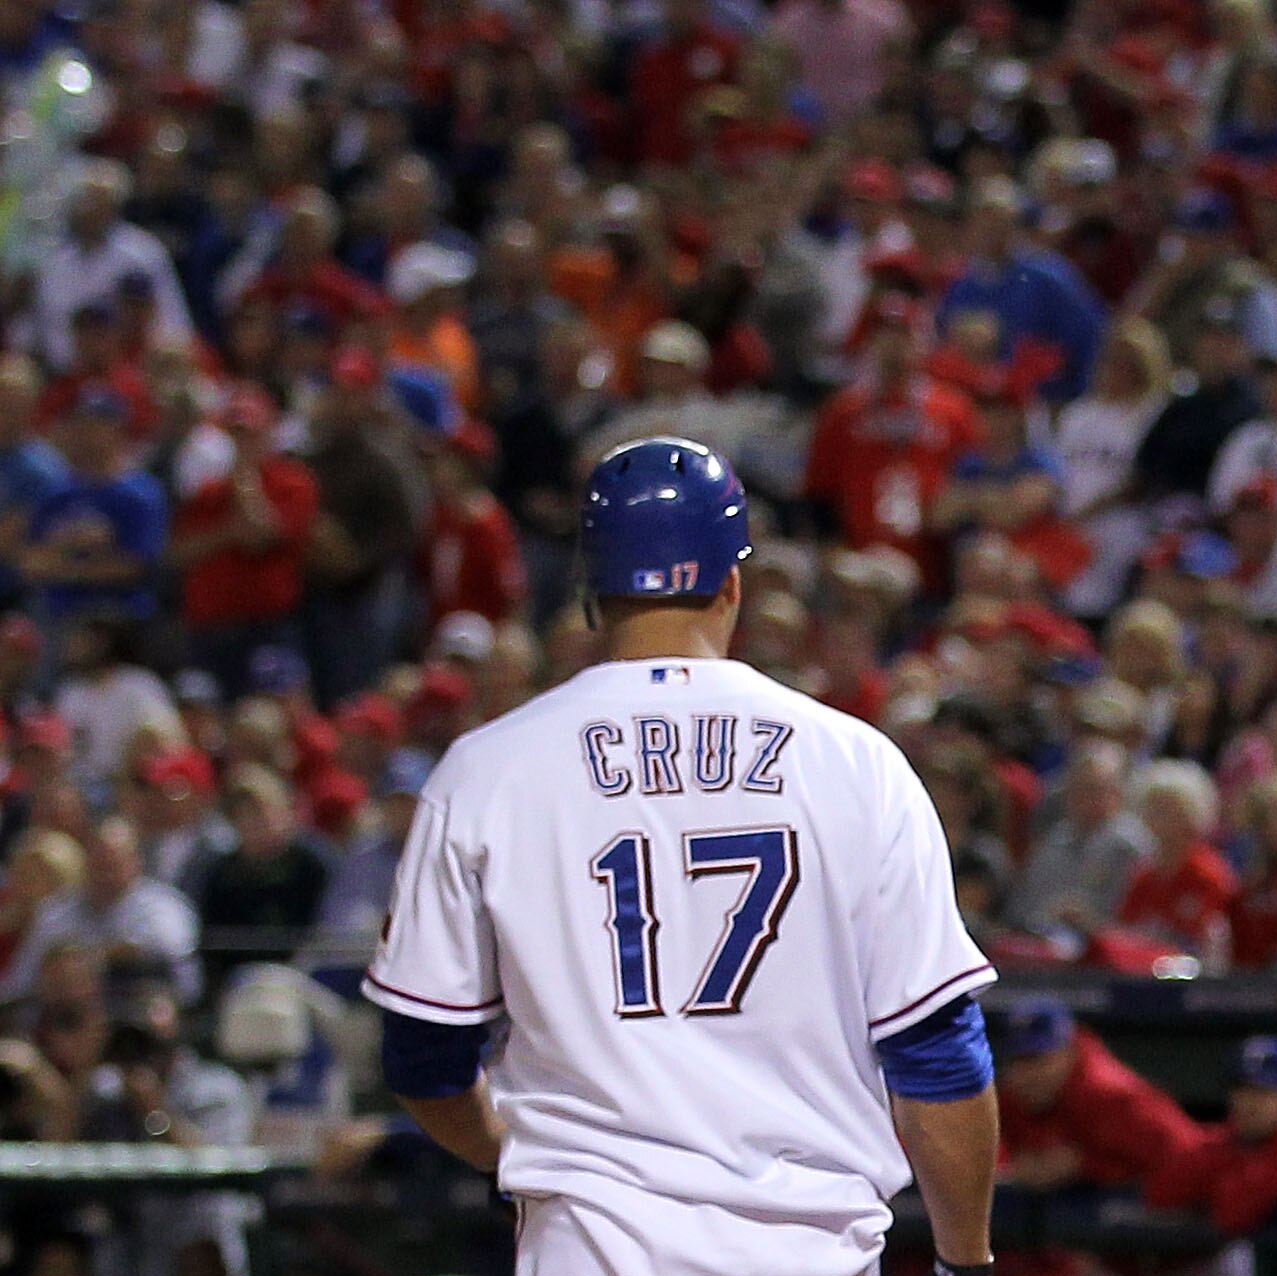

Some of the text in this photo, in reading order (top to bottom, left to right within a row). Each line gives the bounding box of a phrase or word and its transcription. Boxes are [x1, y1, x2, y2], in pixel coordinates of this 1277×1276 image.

[671, 560, 699, 592] 17
[581, 714, 793, 796] CRUZ
[589, 824, 800, 1018] 17
